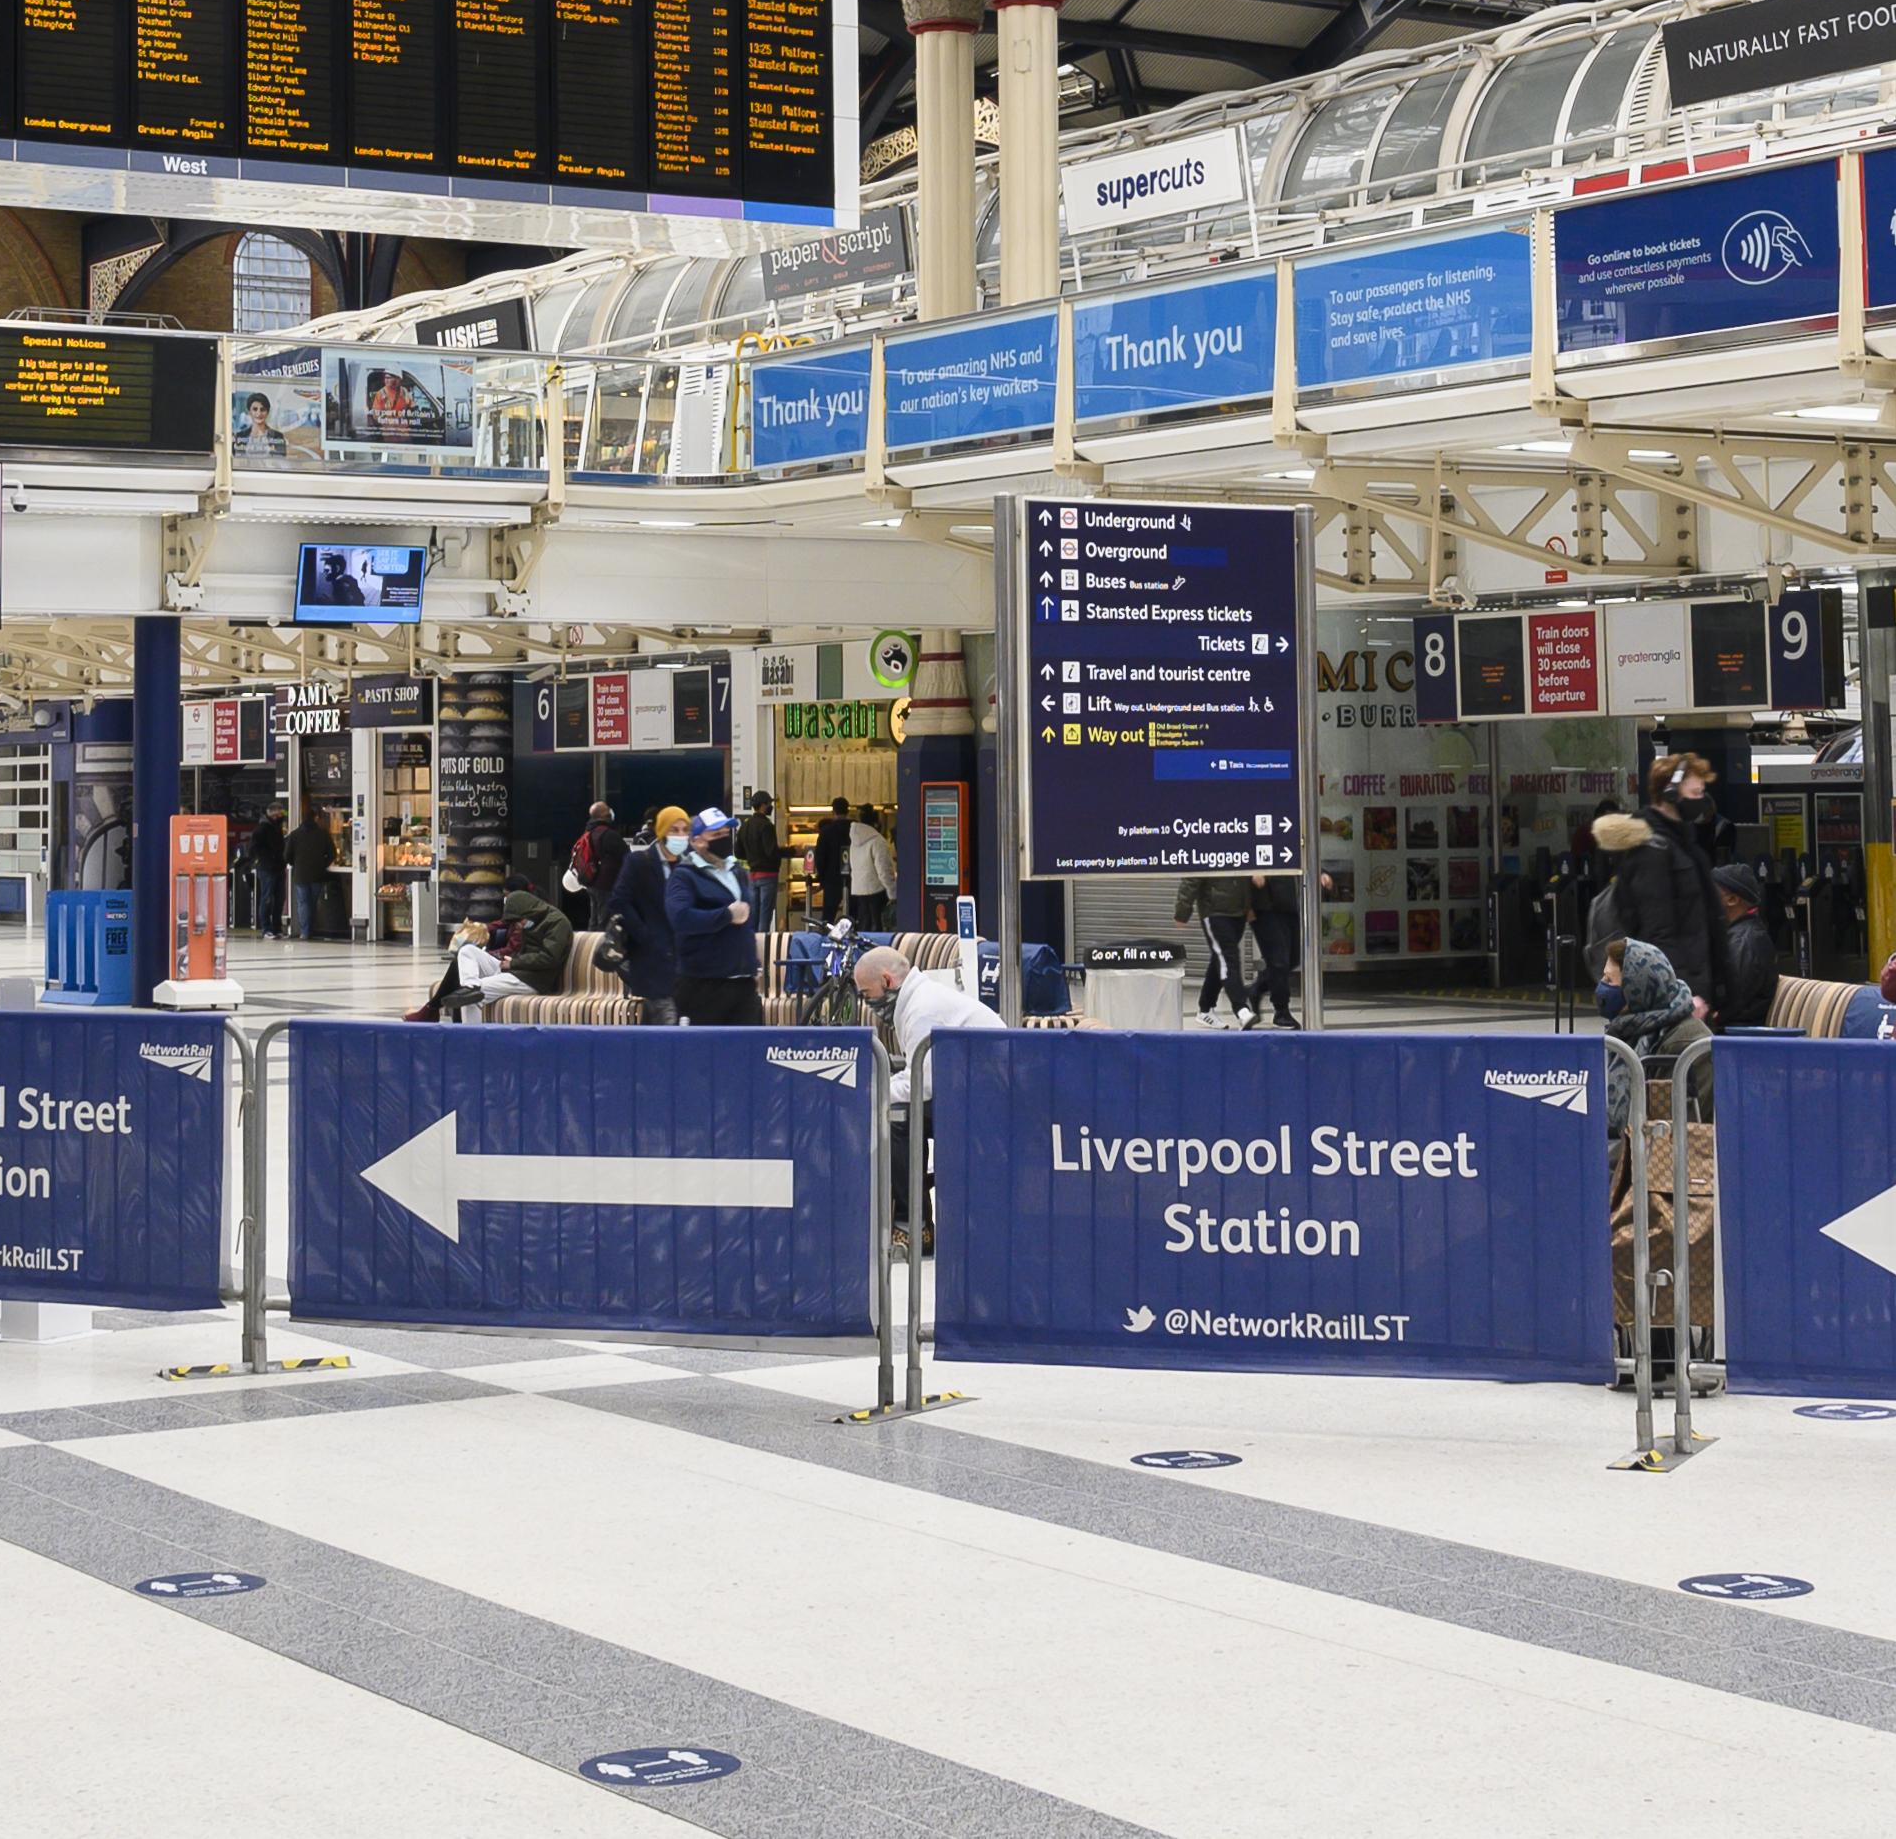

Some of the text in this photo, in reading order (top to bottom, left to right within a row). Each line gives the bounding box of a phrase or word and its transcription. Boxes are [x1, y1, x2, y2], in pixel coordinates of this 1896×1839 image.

[1689, 29, 1790, 69] NATURALLY
[1798, 17, 1840, 44] FAST
[163, 156, 207, 174] West
[1097, 158, 1204, 209] supercuts
[1588, 238, 1700, 265] Go online to book tickets
[437, 325, 478, 348] LUSH
[1105, 325, 1242, 371] Thank you
[900, 345, 1042, 385] To our amazing NHS and
[900, 398, 918, 412] our
[970, 384, 990, 405] key
[993, 378, 1038, 398] workers
[758, 389, 863, 427] Thank you
[1085, 512, 1175, 531] Underground
[1086, 542, 1167, 562] Overground
[1086, 573, 1126, 589] Buses
[1087, 603, 1252, 623] Stansted Express tickets
[1198, 636, 1245, 651] Tickets
[1782, 611, 1807, 659] 9
[1425, 633, 1445, 676] 8
[1618, 650, 1680, 667] greateranglia
[1086, 665, 1250, 681] Travel and tourist centre
[365, 686, 419, 703] PASTY SHOP
[538, 689, 549, 720] 6
[718, 678, 729, 711] 7
[1088, 696, 1111, 711] Lift
[286, 710, 340, 735] COFFEE
[1088, 727, 1144, 745] Way out
[1119, 818, 1248, 837] By platform 10 Cycle racks
[1162, 849, 1249, 867] Left Luggage
[140, 1043, 213, 1061] NetworkRail
[766, 1046, 860, 1066] NetworkRail
[1483, 1069, 1589, 1089] NetworkRail
[18, 1088, 132, 1134] Street
[1052, 1124, 1477, 1187] Liverpool Street
[1165, 1204, 1359, 1255] Station
[1165, 1309, 1409, 1340] @NetworkRailLST
